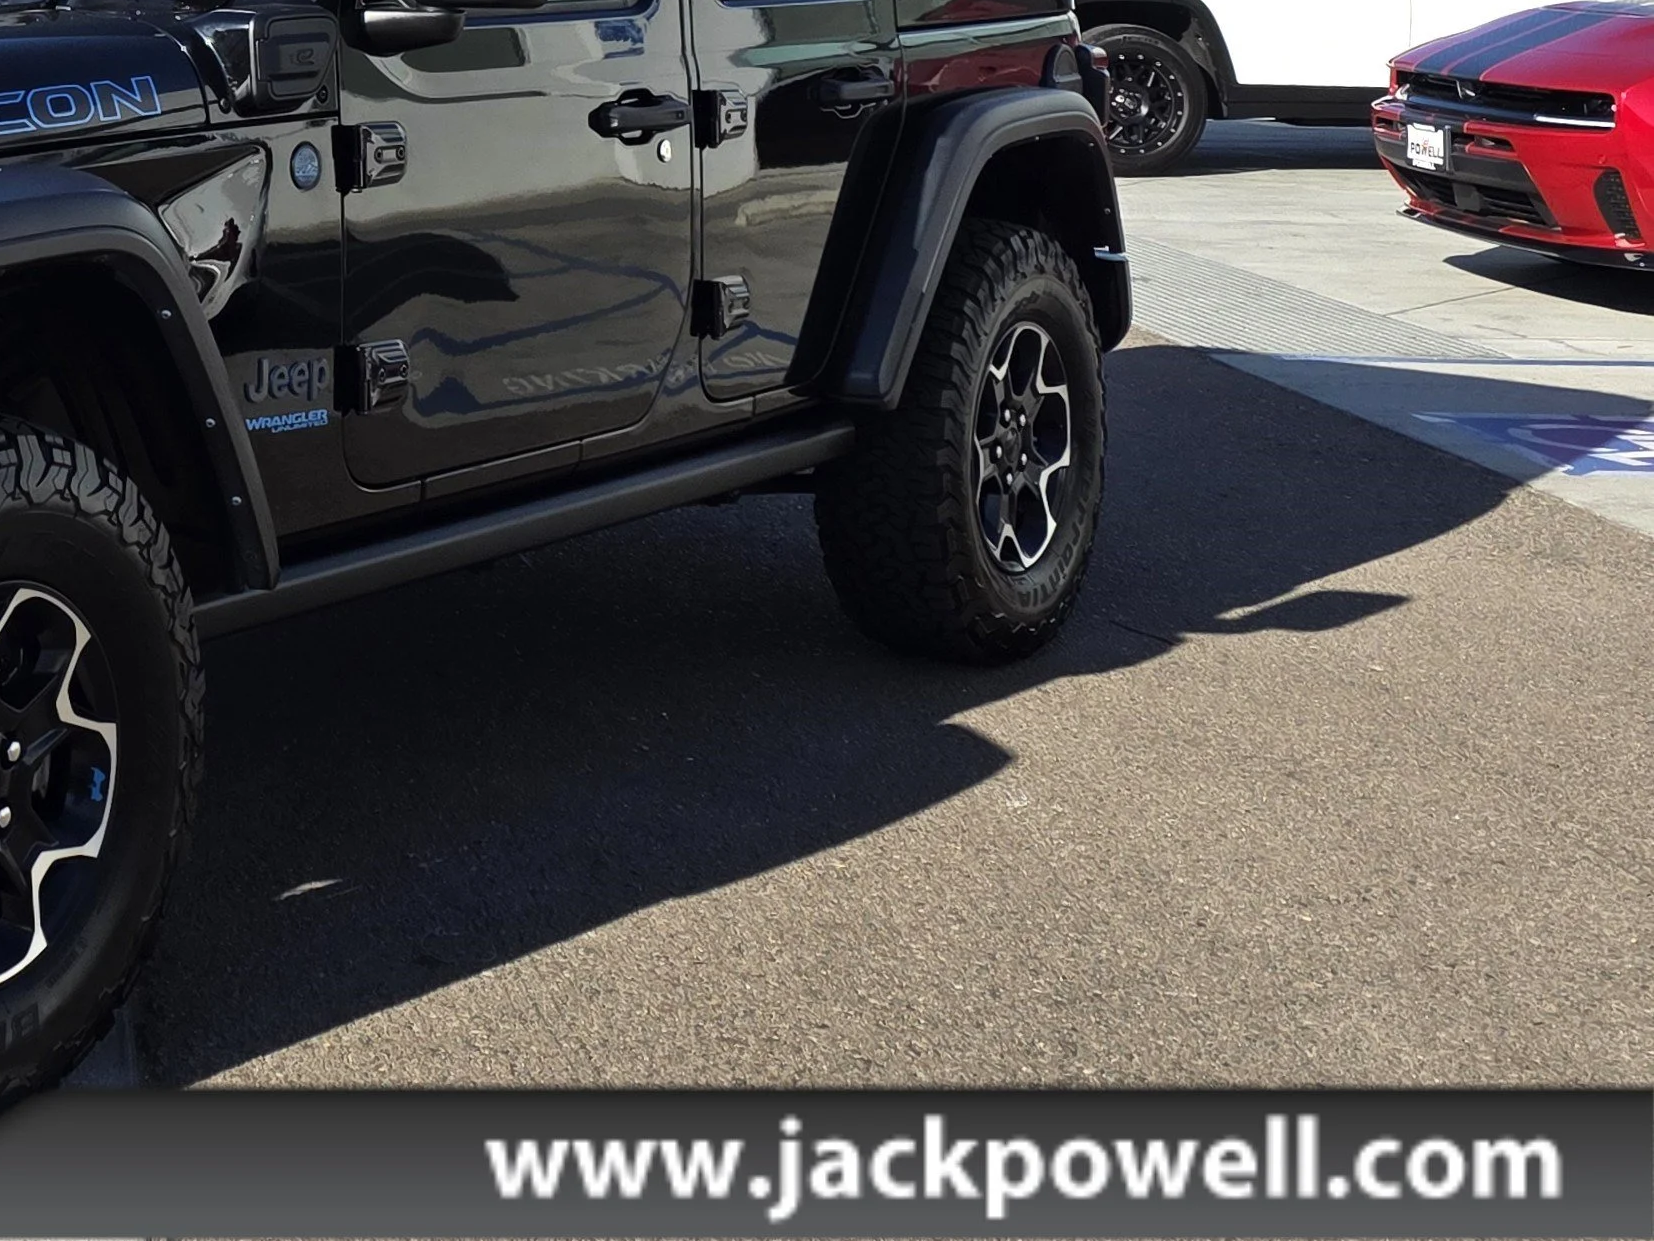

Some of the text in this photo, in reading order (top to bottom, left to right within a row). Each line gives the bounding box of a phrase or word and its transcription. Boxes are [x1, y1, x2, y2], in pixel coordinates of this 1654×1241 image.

[1410, 142, 1443, 159] POWELL
[245, 358, 330, 403] Jeep
[245, 409, 328, 431] WRANGLER
